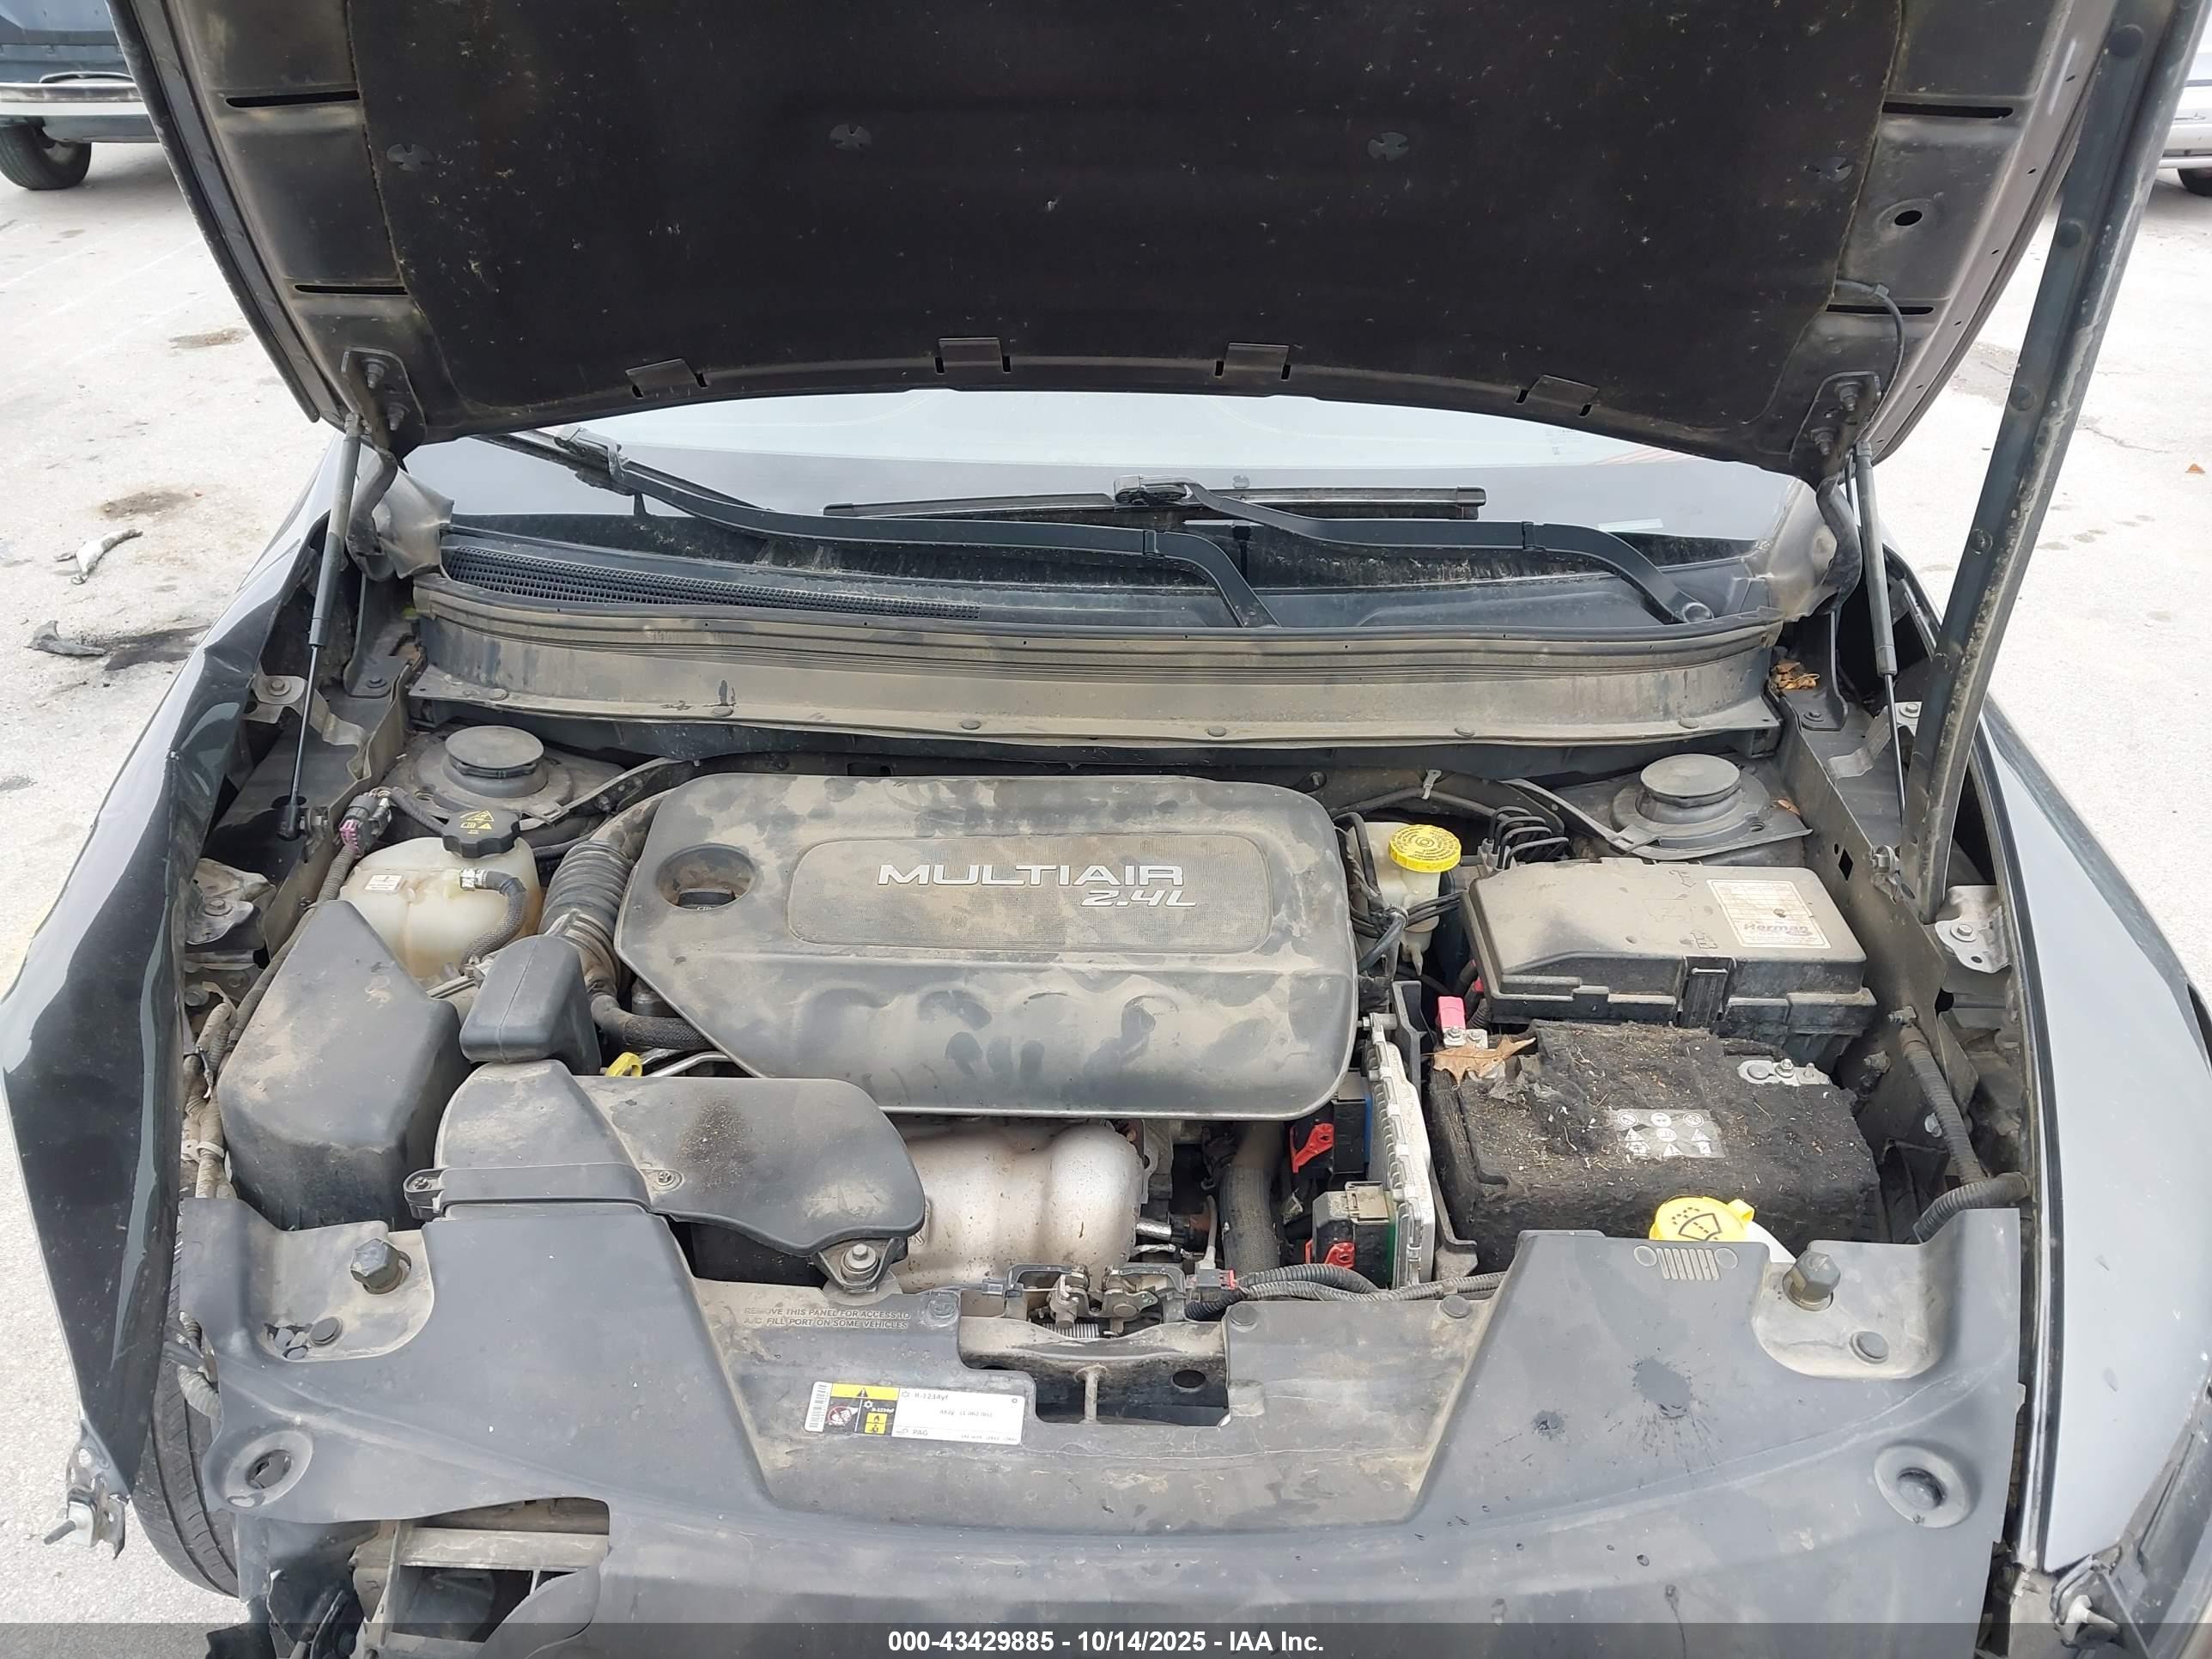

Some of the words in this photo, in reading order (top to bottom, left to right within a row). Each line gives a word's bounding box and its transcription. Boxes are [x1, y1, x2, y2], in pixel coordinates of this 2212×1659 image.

[877, 865, 1184, 886] MULTIAIR
[1080, 890, 1197, 907] 2.4L
[809, 1309, 838, 1317] PANEL
[841, 1310, 859, 1318] FOR
[860, 1310, 896, 1319] ACCESS
[767, 1317, 786, 1326] FILL
[789, 1318, 813, 1327] PORT
[833, 1319, 859, 1328] SOME
[863, 1320, 908, 1328] VEHICLES
